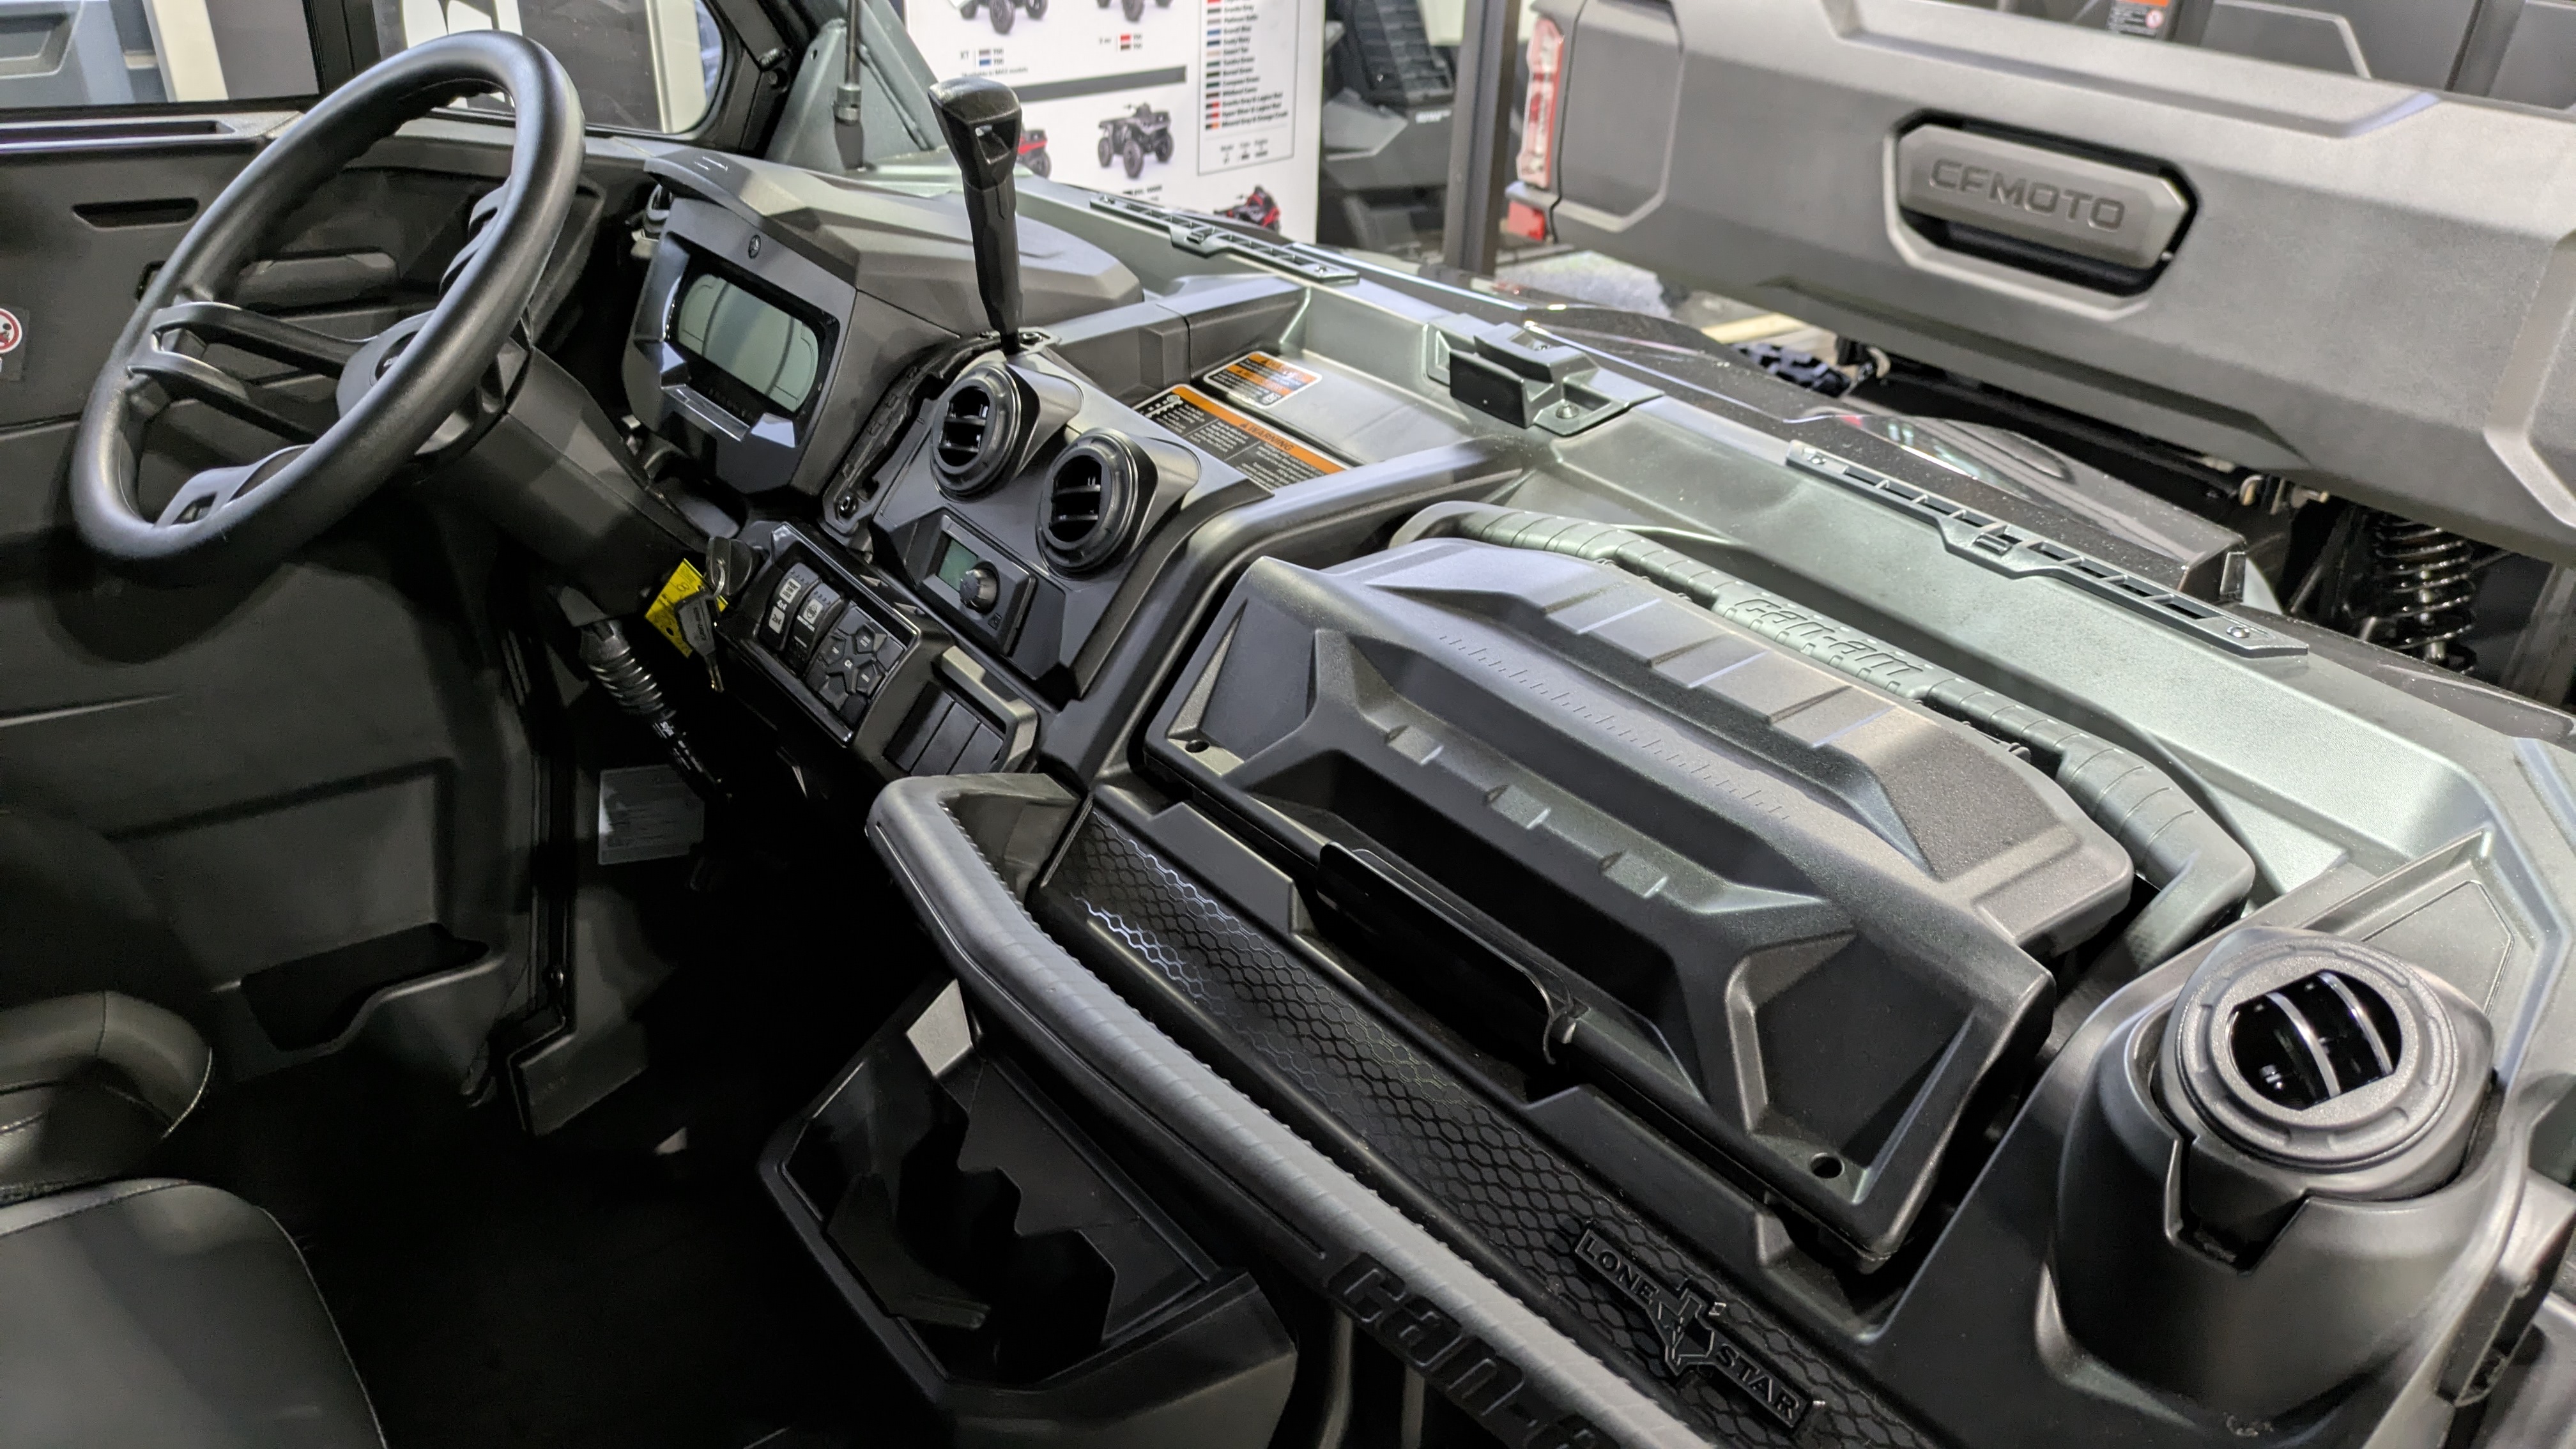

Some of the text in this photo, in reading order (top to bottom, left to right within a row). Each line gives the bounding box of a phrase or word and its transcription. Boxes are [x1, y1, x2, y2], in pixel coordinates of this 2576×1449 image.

[1929, 158, 2126, 232] CFMOTO
[1249, 425, 1294, 451] WARNING
[1584, 1237, 1800, 1420] LONE STAR
